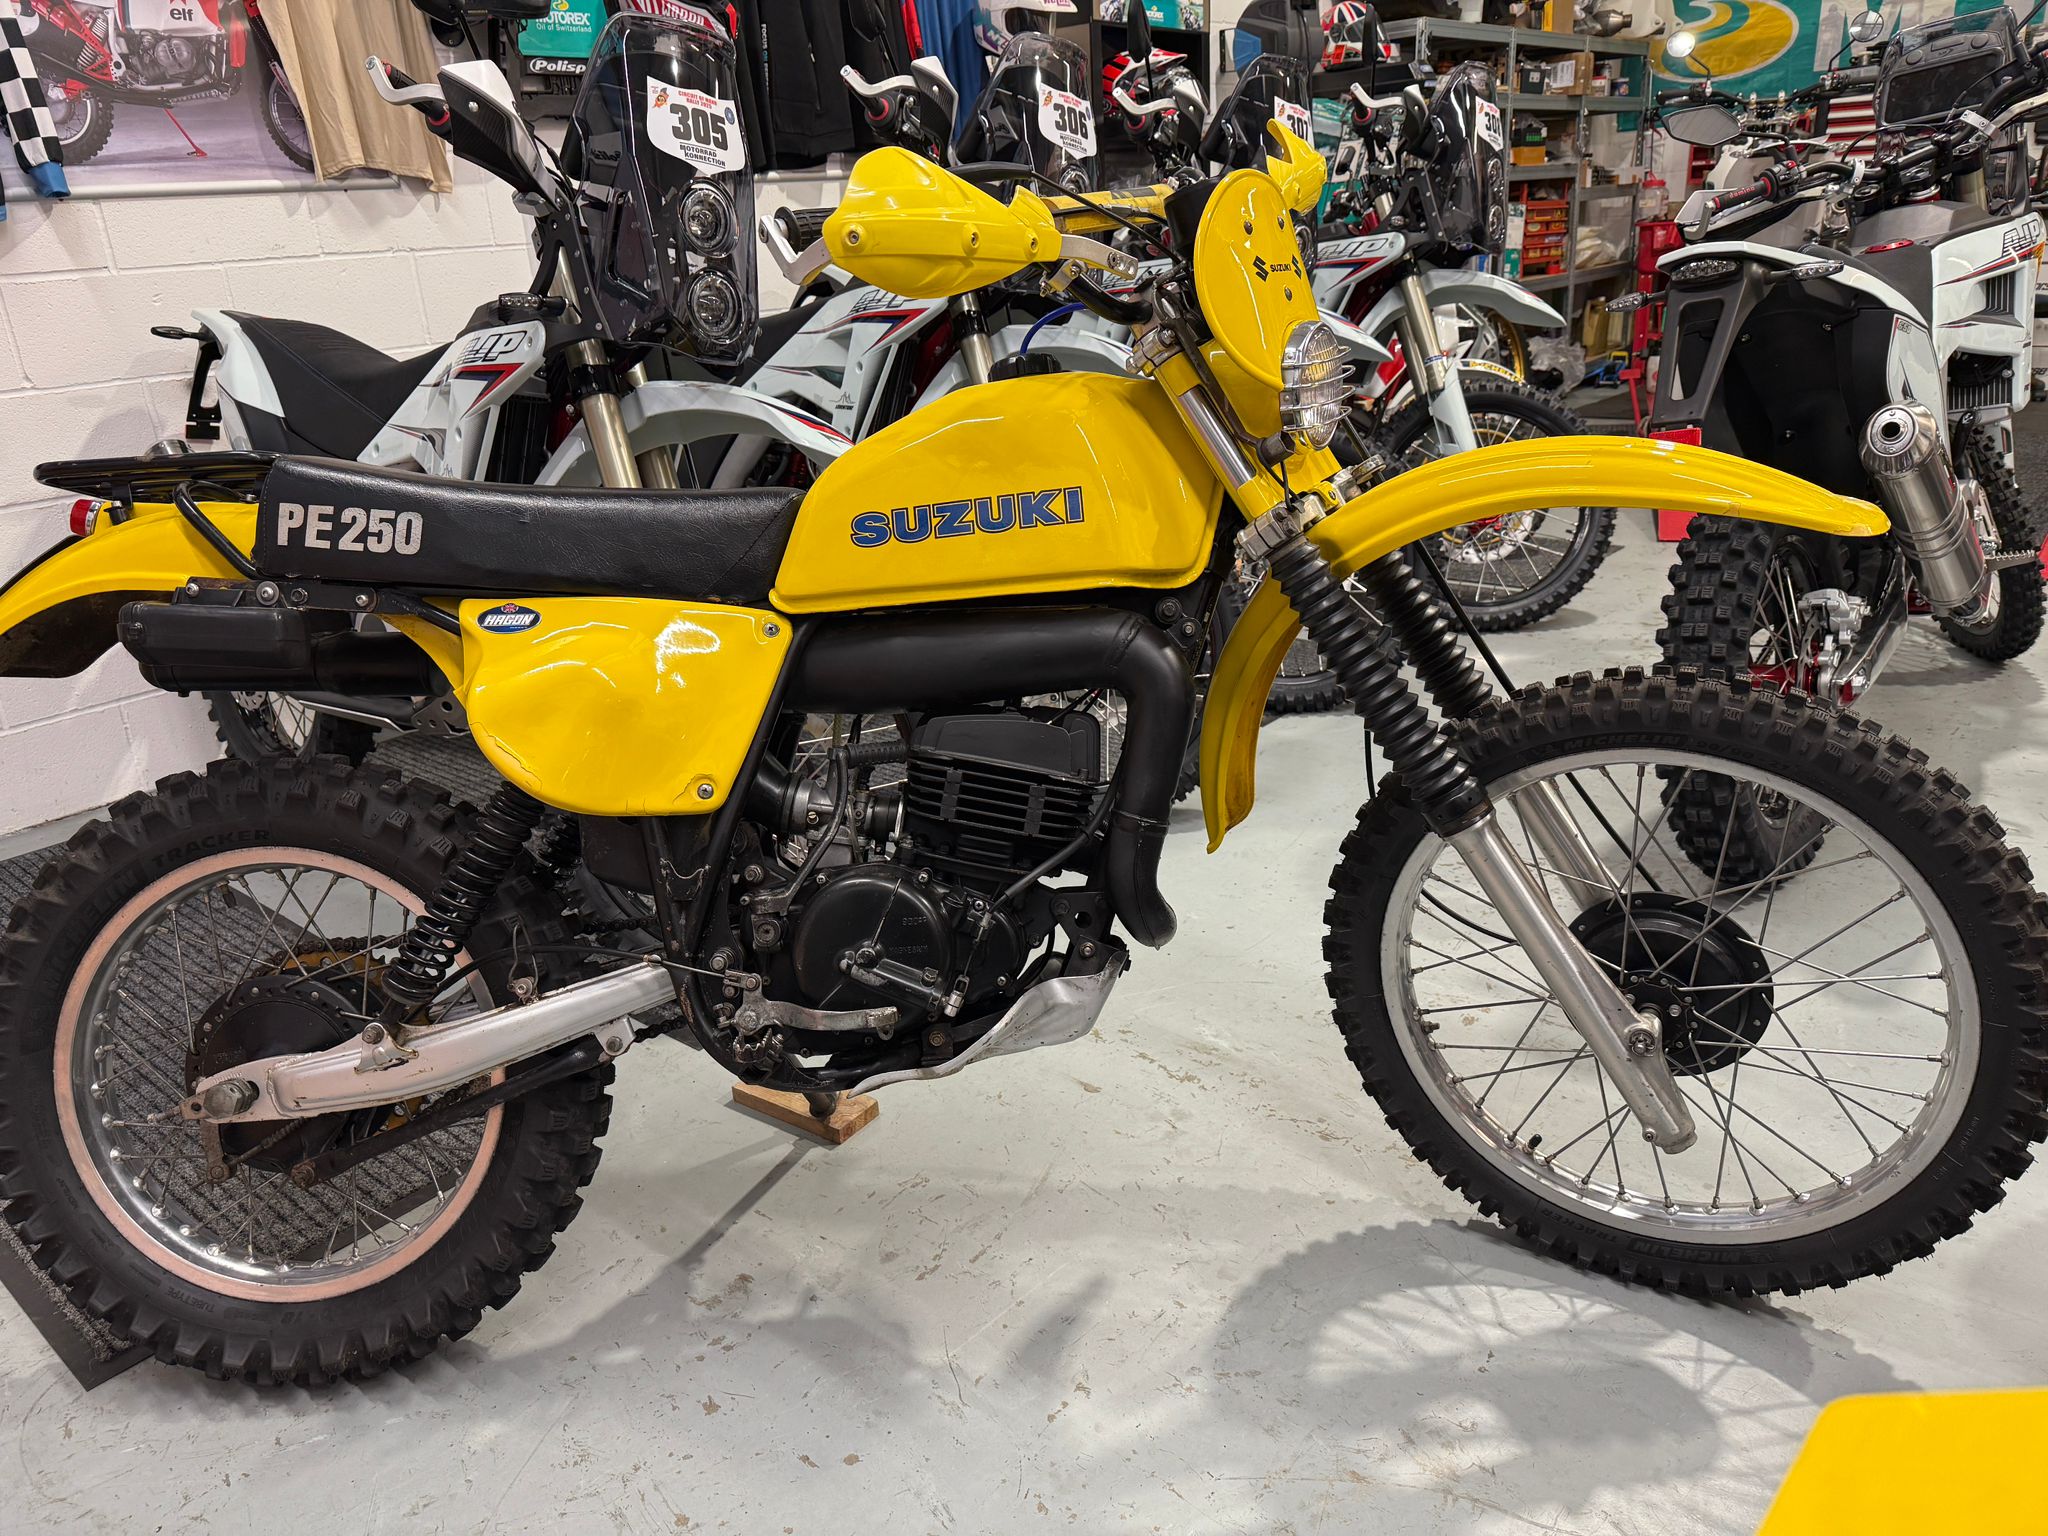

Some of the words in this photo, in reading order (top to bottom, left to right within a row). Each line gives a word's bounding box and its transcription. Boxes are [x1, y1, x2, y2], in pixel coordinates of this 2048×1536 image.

[169, 8, 193, 21] elf
[556, 24, 592, 32] Switzerland
[669, 102, 729, 151] 305
[1053, 102, 1088, 140] 306
[680, 144, 717, 158] MOTORRAD
[684, 150, 726, 167] KONNECTION
[1729, 186, 1756, 198] domino
[1270, 264, 1292, 272] SUZUKI
[850, 485, 1085, 548] SUZUKI
[277, 502, 334, 550] PE
[338, 507, 423, 555] 250
[481, 614, 537, 626] HAGON
[1562, 733, 1680, 751] MICHELIN
[151, 829, 271, 868] TRACKER
[1540, 1208, 1617, 1244] TRACKER
[1632, 1240, 1742, 1264] MICHELIN
[166, 1286, 216, 1313] TUBETYPE
